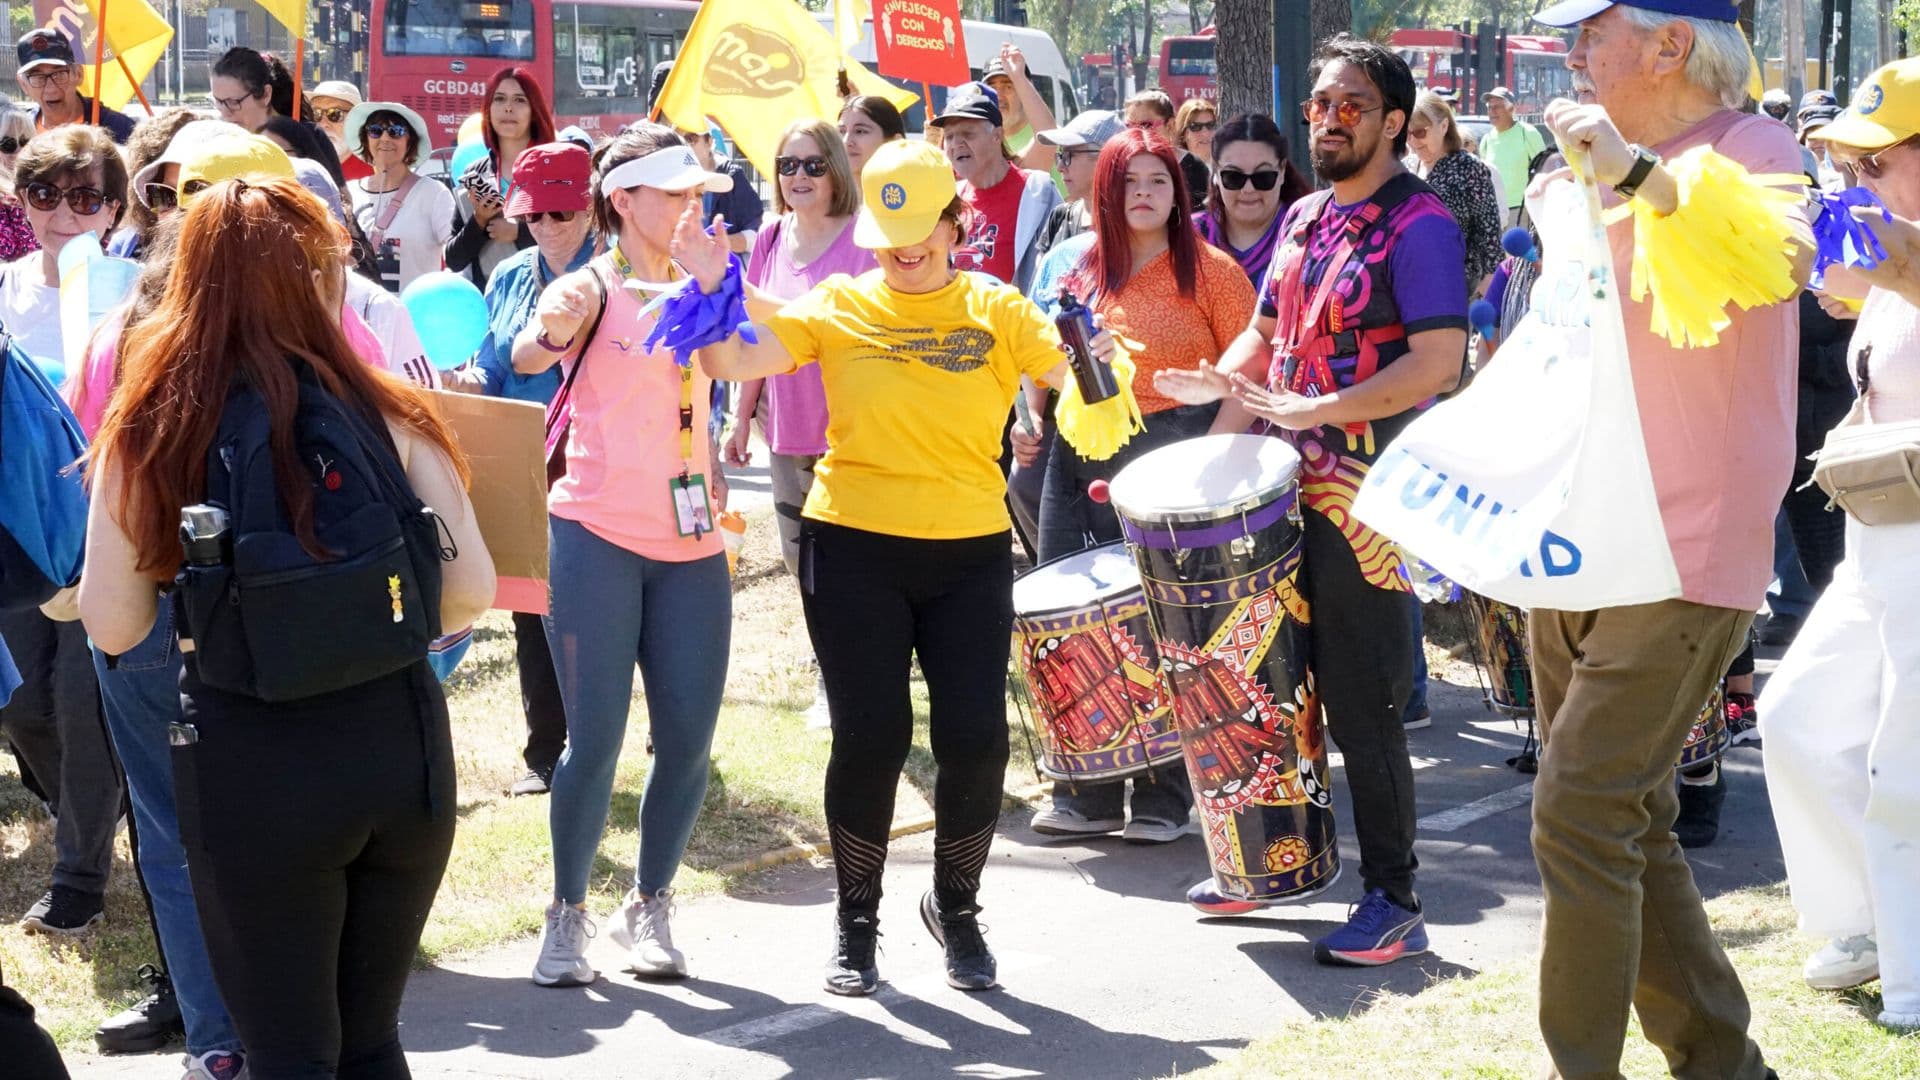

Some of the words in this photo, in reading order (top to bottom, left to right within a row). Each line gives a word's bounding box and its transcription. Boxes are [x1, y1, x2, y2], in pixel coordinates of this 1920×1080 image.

[884, 0, 941, 23] ENVEJECER
[901, 17, 925, 32] CON
[896, 33, 945, 51] DERECHOS
